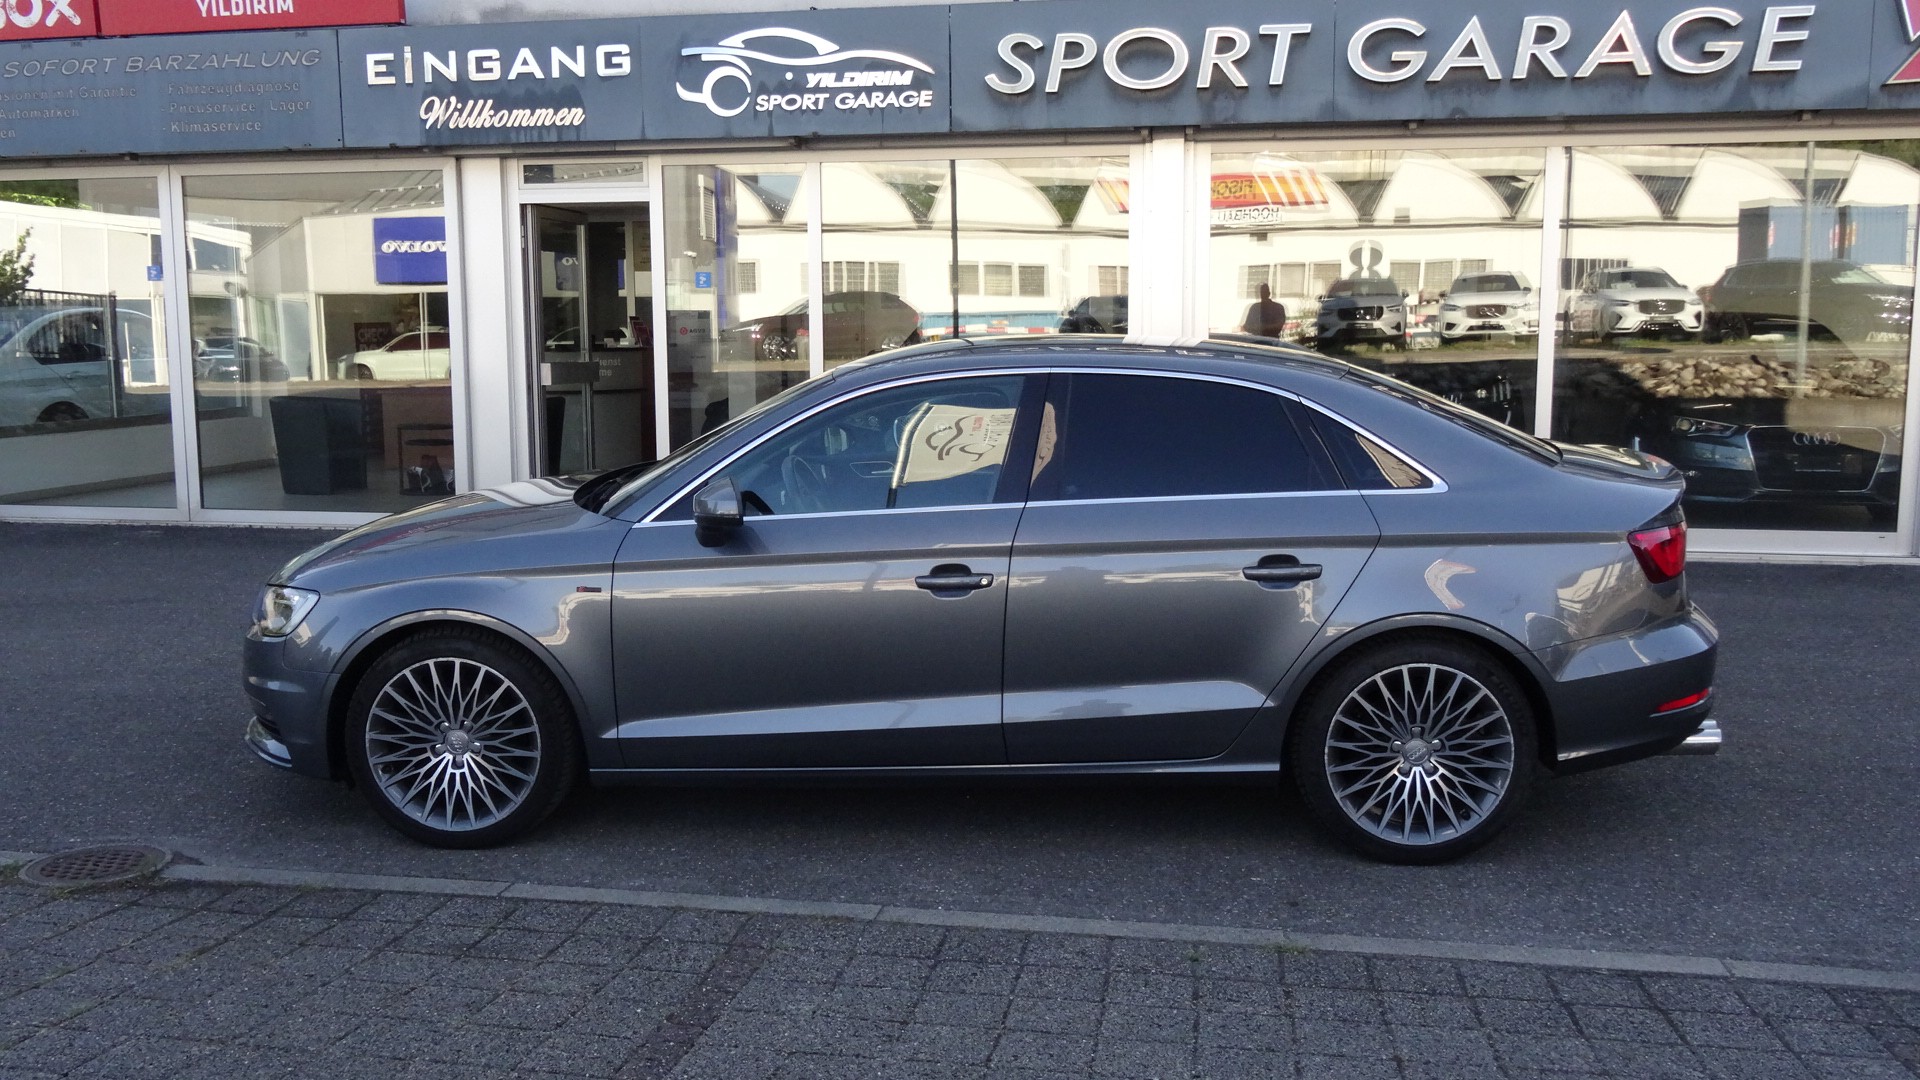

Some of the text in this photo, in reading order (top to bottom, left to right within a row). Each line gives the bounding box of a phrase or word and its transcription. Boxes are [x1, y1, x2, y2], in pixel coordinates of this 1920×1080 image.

[0, 0, 81, 29] OX
[196, 0, 294, 17] YILDIRIM
[984, 5, 1816, 94] SPORT GARAGE
[3, 50, 321, 78] SOFORT BARZAHLUNG
[168, 81, 300, 97] Fahrzeugdiagnose
[805, 70, 914, 89] YILDIRIM
[79, 85, 137, 99] Garantie
[755, 90, 933, 112] SPORT GARAGE
[169, 99, 312, 114] Pneuservice Lager
[420, 96, 585, 130] Willkommen
[171, 120, 262, 133] Klimaservice
